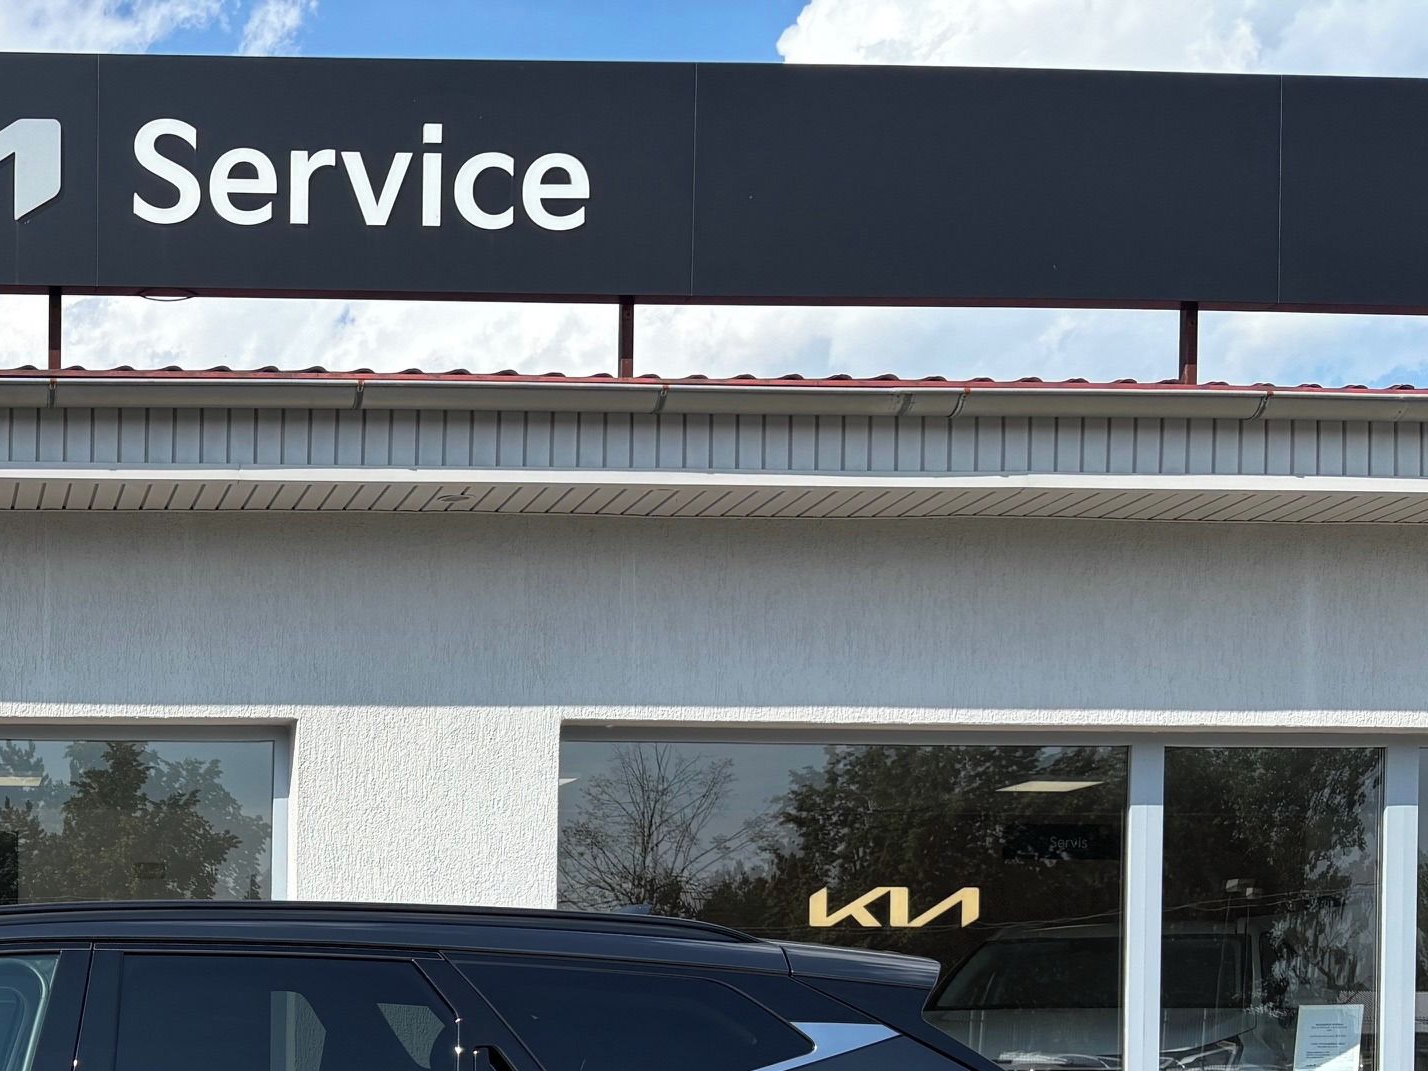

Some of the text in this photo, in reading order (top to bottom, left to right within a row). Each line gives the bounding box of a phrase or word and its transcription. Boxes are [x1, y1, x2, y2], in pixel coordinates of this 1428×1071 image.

[132, 117, 590, 231] Service
[1050, 836, 1088, 849] Servis
[809, 887, 979, 928] KIA
